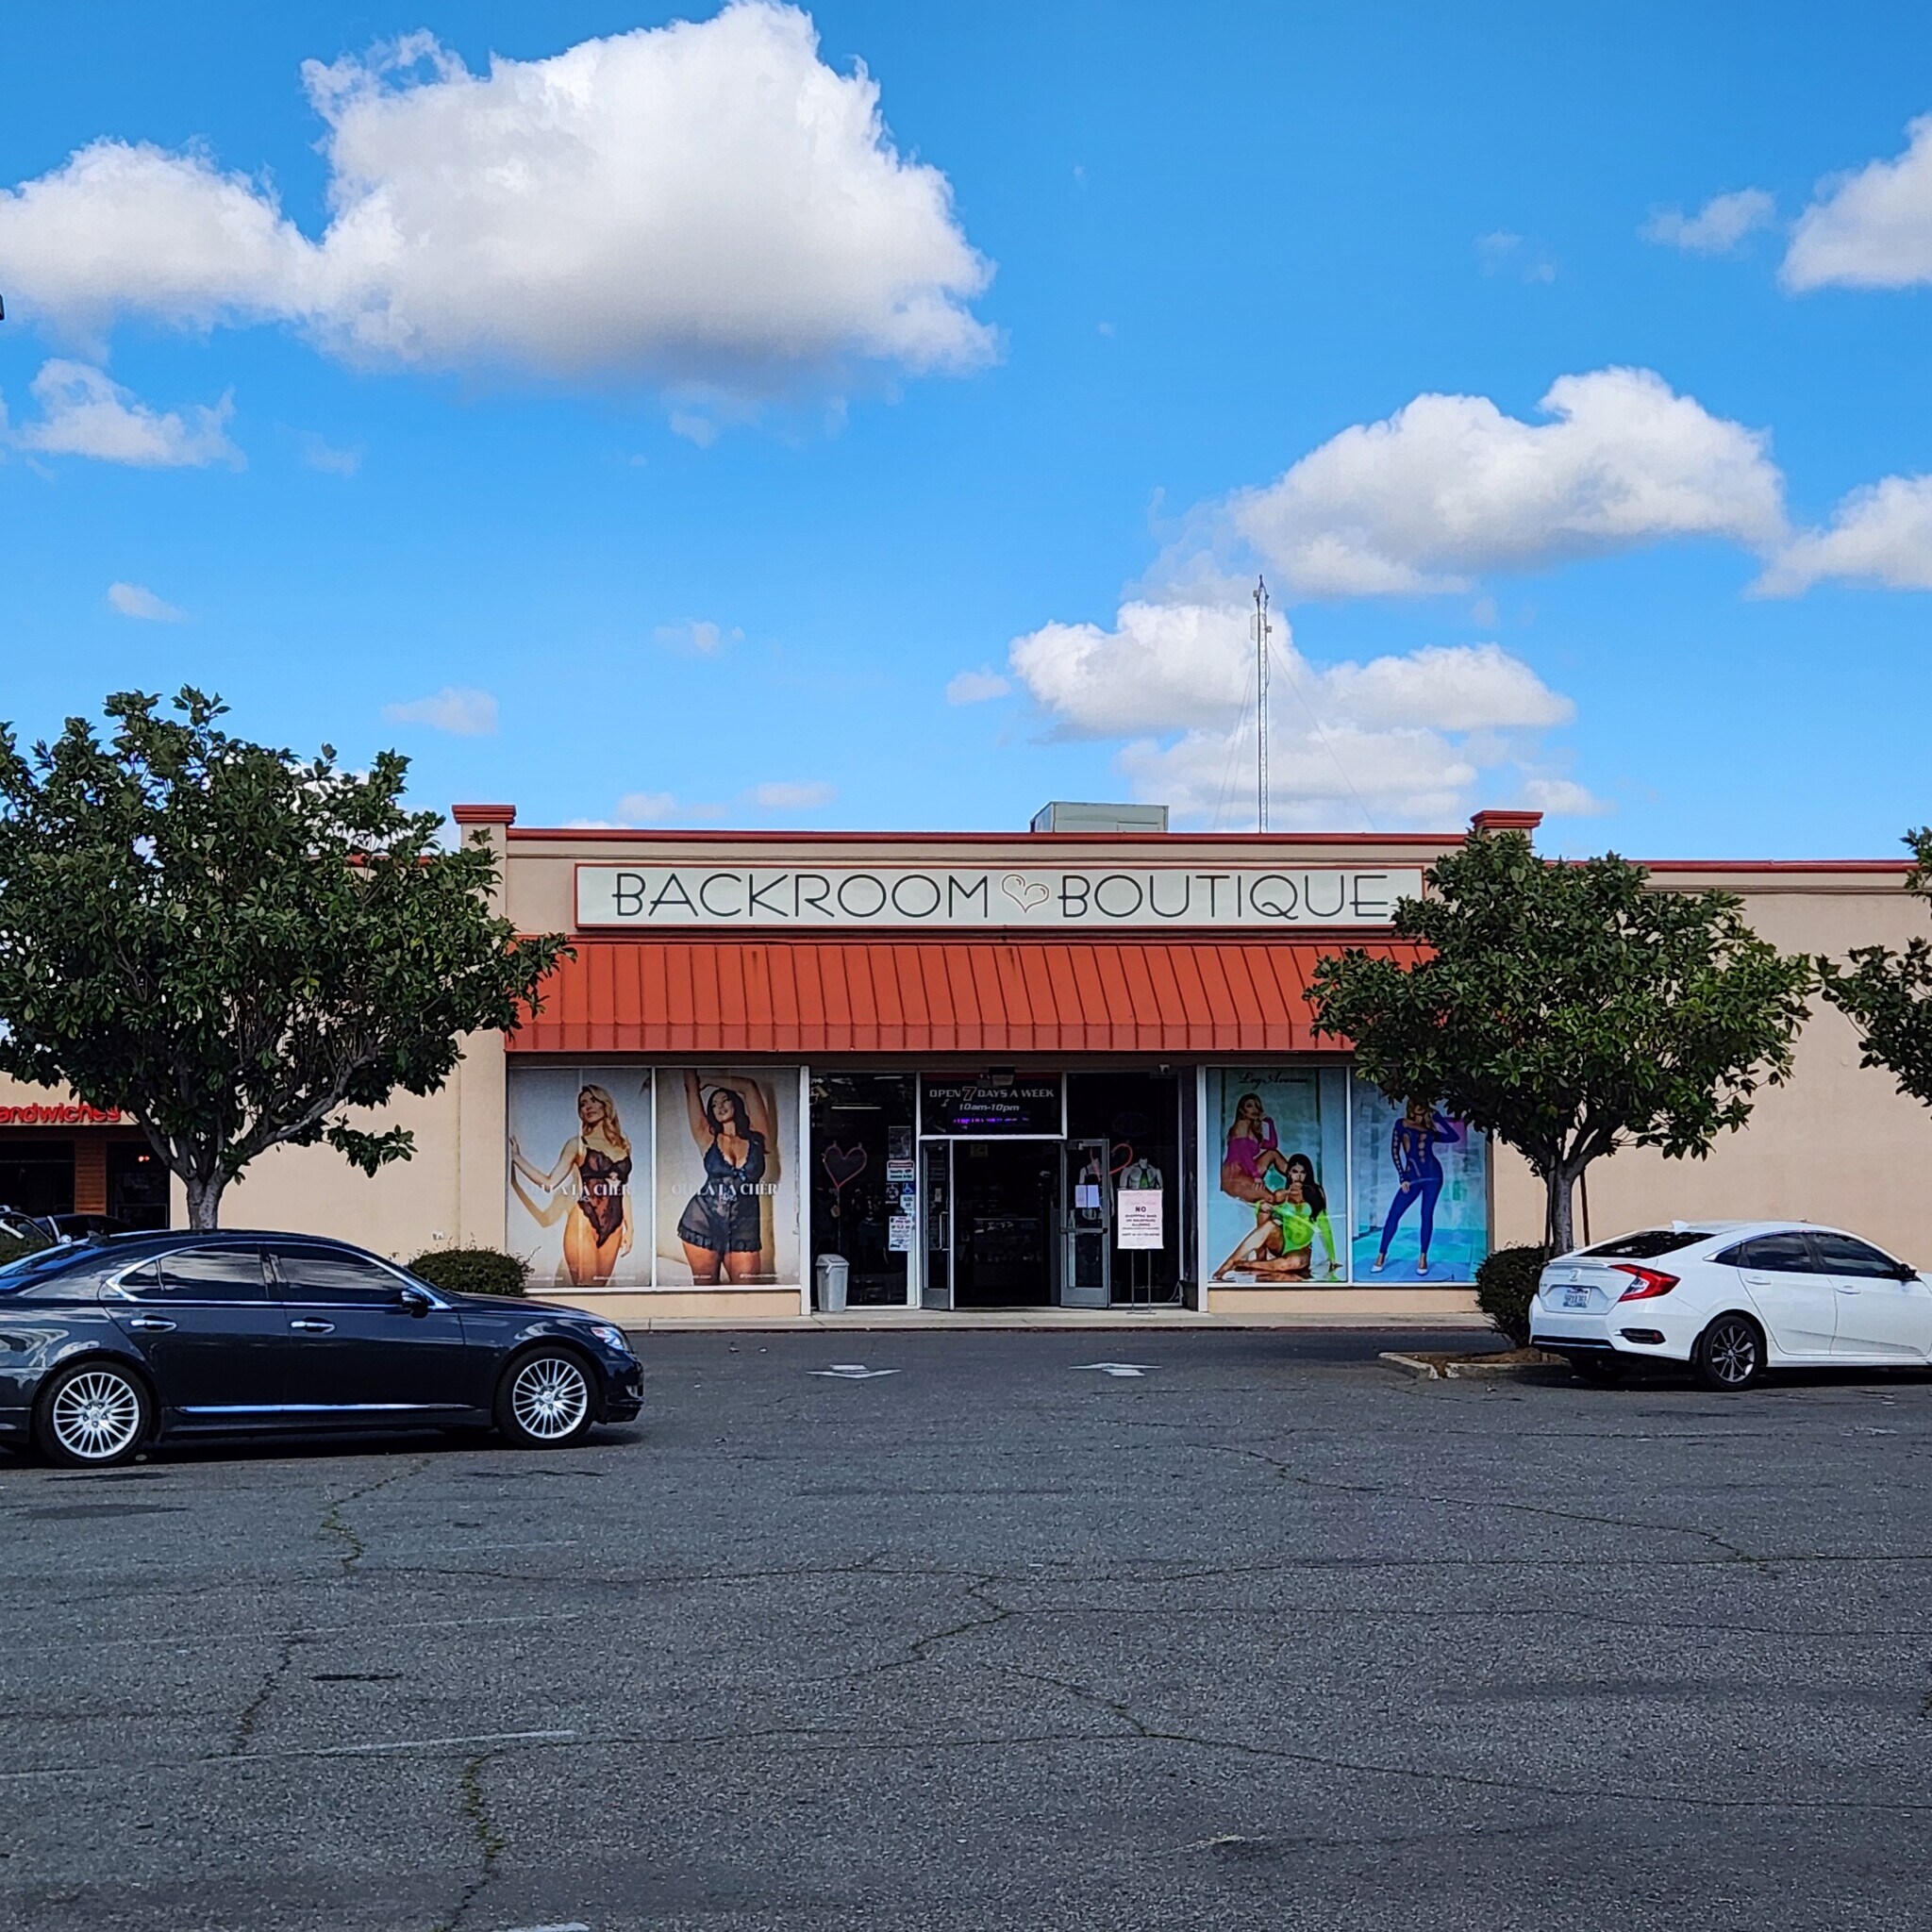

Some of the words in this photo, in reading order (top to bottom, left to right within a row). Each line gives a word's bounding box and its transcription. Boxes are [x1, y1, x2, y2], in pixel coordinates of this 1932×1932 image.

[612, 873, 989, 918] BACKROOM
[1058, 874, 1389, 920] BOUTIQUE
[929, 1089, 961, 1098] OPEN
[962, 1086, 977, 1102] 7
[977, 1089, 1008, 1098] DAYS
[1009, 1089, 1018, 1098] A
[1021, 1089, 1055, 1098] WEEK
[958, 1103, 1020, 1112] 10am-10pm
